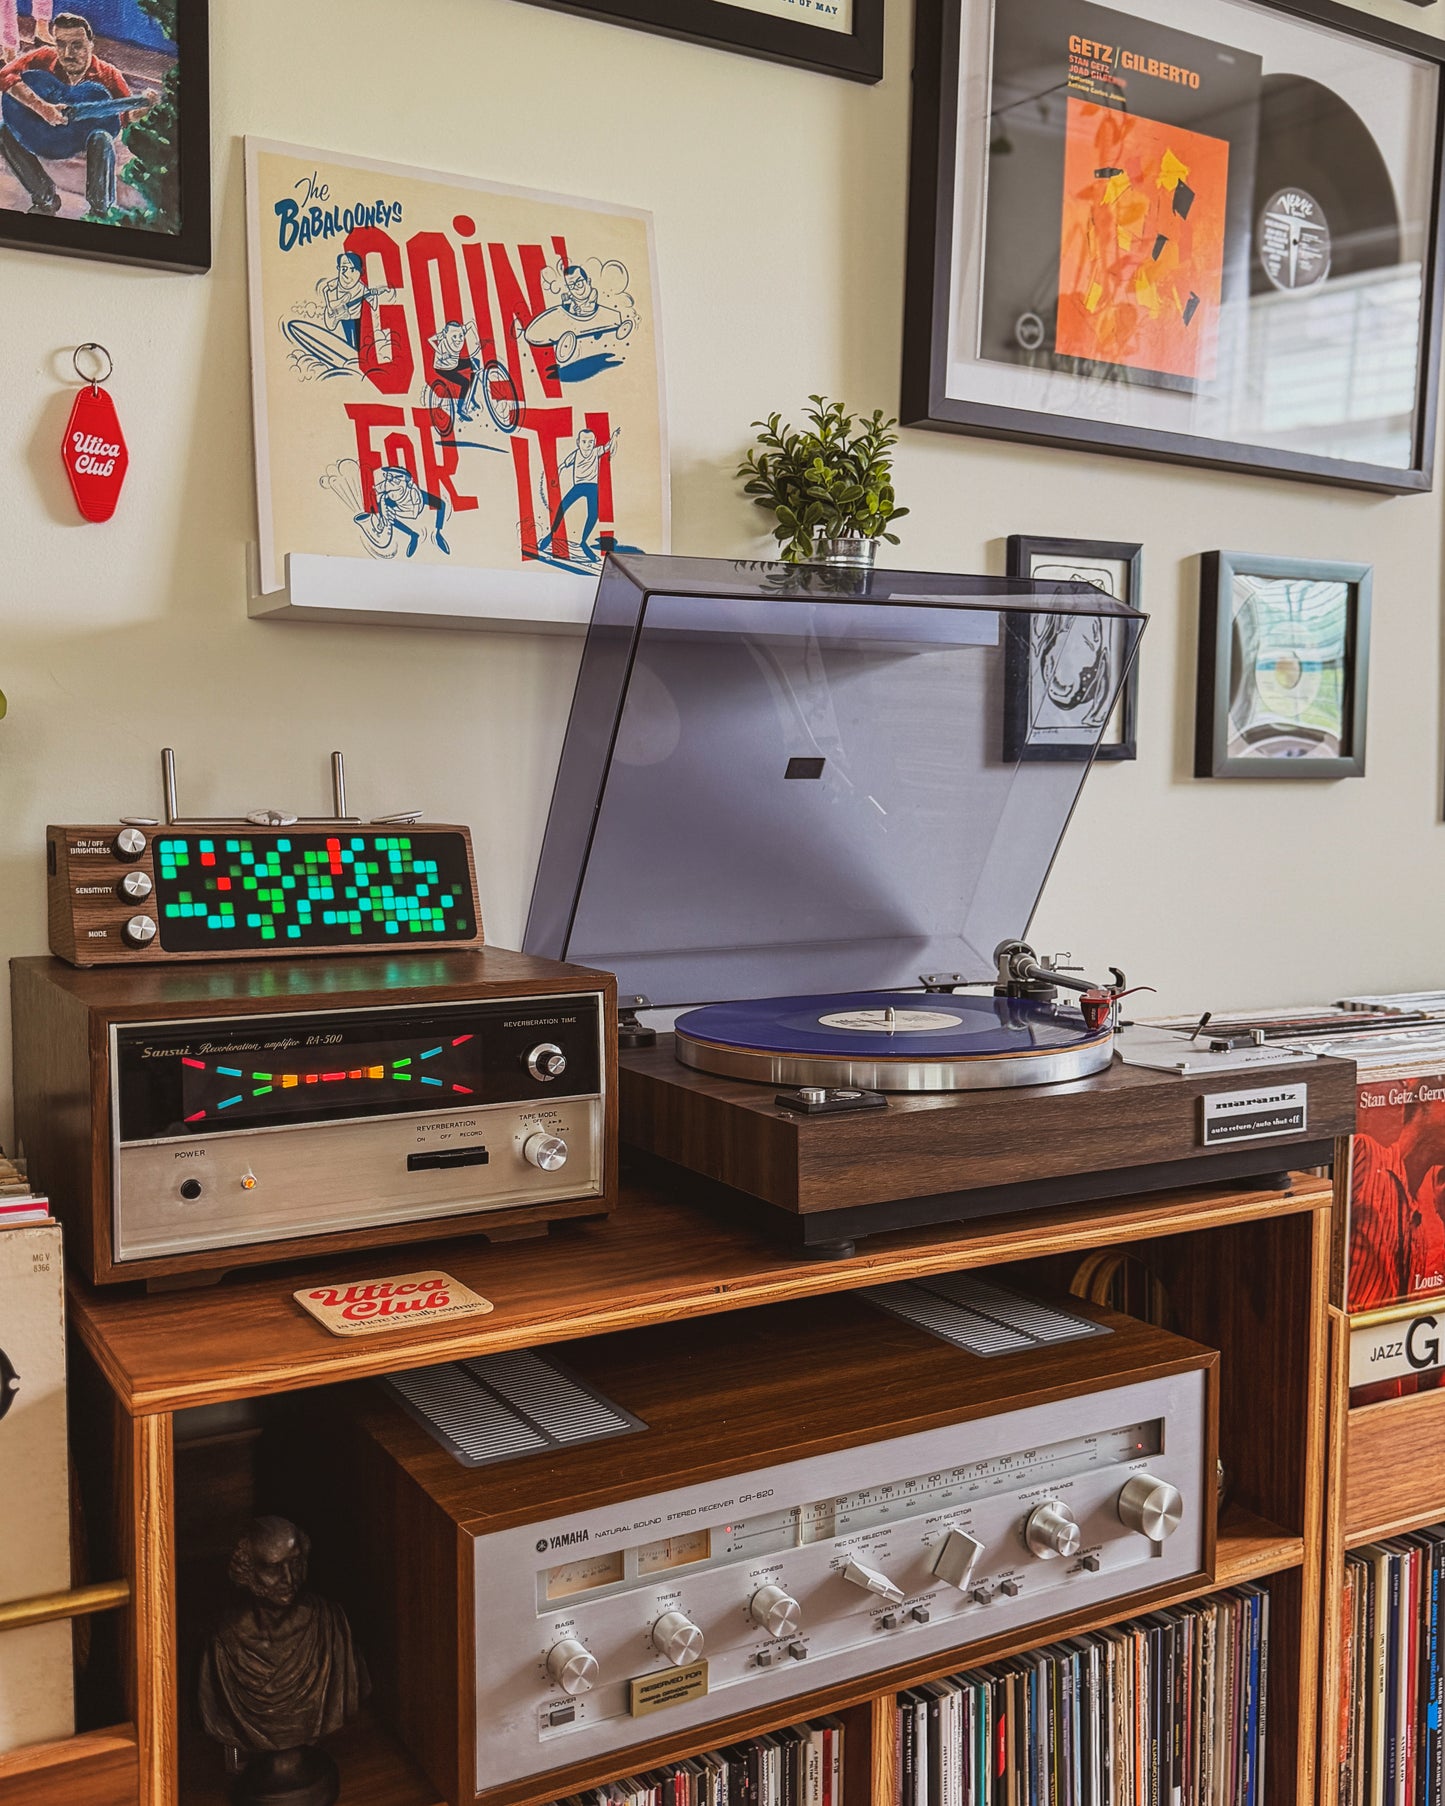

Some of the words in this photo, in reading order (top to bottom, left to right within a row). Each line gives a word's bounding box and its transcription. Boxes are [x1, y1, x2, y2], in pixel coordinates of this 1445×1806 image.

[816, 2, 838, 14] MAY
[1069, 55, 1089, 68] STAN
[1090, 60, 1110, 74] GETZ
[294, 171, 331, 208] The
[275, 199, 403, 252] BABALOONEYS
[73, 431, 121, 457] Utica
[343, 403, 479, 513] FOR
[75, 455, 115, 477] Club
[70, 847, 111, 855] BRIGHTNESS
[75, 886, 112, 894] SENSITIVITY
[88, 930, 107, 938] MODE
[504, 1018, 559, 1028] REVERBERATION
[141, 1045, 192, 1058] Sansui
[264, 1038, 300, 1050] amplifier
[306, 1034, 343, 1045] RA-500
[1216, 1093, 1296, 1110] marantz
[1360, 1091, 1386, 1109] Stan
[1389, 1088, 1413, 1105] Getz
[519, 1113, 536, 1121] TAPE
[1273, 1117, 1287, 1126] shut
[1289, 1115, 1300, 1124] off
[417, 1120, 476, 1131] REVERBERATION
[174, 1149, 206, 1159] POWER
[33, 1254, 44, 1262] MG
[45, 1253, 50, 1261] V
[33, 1264, 50, 1272] 8366
[1414, 1270, 1444, 1290] Louis
[308, 1279, 450, 1307] Utica
[342, 1291, 450, 1320] Club
[1370, 1342, 1403, 1362] JAZZ
[1405, 1315, 1440, 1369] G
[1129, 1462, 1148, 1471] TUNING
[734, 1523, 745, 1531] FM
[835, 1497, 848, 1505] 92
[858, 1491, 870, 1500] 94
[881, 1485, 893, 1494] 96
[905, 1479, 916, 1488] 98
[928, 1474, 941, 1482] 100
[952, 1468, 965, 1476] 102
[975, 1462, 988, 1470] 104
[1000, 1456, 1012, 1465] 106
[1018, 1490, 1040, 1500] VOLUME
[1050, 1481, 1074, 1491] BALANCE
[550, 1529, 589, 1549] YAMAHA
[594, 1524, 632, 1539] NATURAL
[633, 1517, 662, 1529] SOUND
[667, 1508, 697, 1521] STEREO
[699, 1499, 735, 1513] RECEIVER
[739, 1488, 774, 1504] CR-620
[926, 1515, 942, 1524] INPUT
[943, 1507, 972, 1520] SELECTOR
[834, 1540, 846, 1548] REC
[848, 1536, 861, 1545] OUT
[862, 1529, 892, 1541] SELECTOR
[750, 1564, 784, 1577] LOUDNESS
[971, 1578, 989, 1587] TUNER
[657, 1591, 682, 1602] TREBLE
[904, 1598, 918, 1606] HIGH
[919, 1593, 937, 1602] FILTER
[869, 1608, 884, 1617] LOW
[884, 1603, 902, 1613] FILTER
[555, 1619, 575, 1629] BASS
[763, 1634, 796, 1647] SPEAKERS
[640, 1676, 684, 1693] RESERVED
[685, 1670, 703, 1680] FOR
[1429, 1652, 1437, 1700] INDICATIONS
[549, 1697, 577, 1708] POWER
